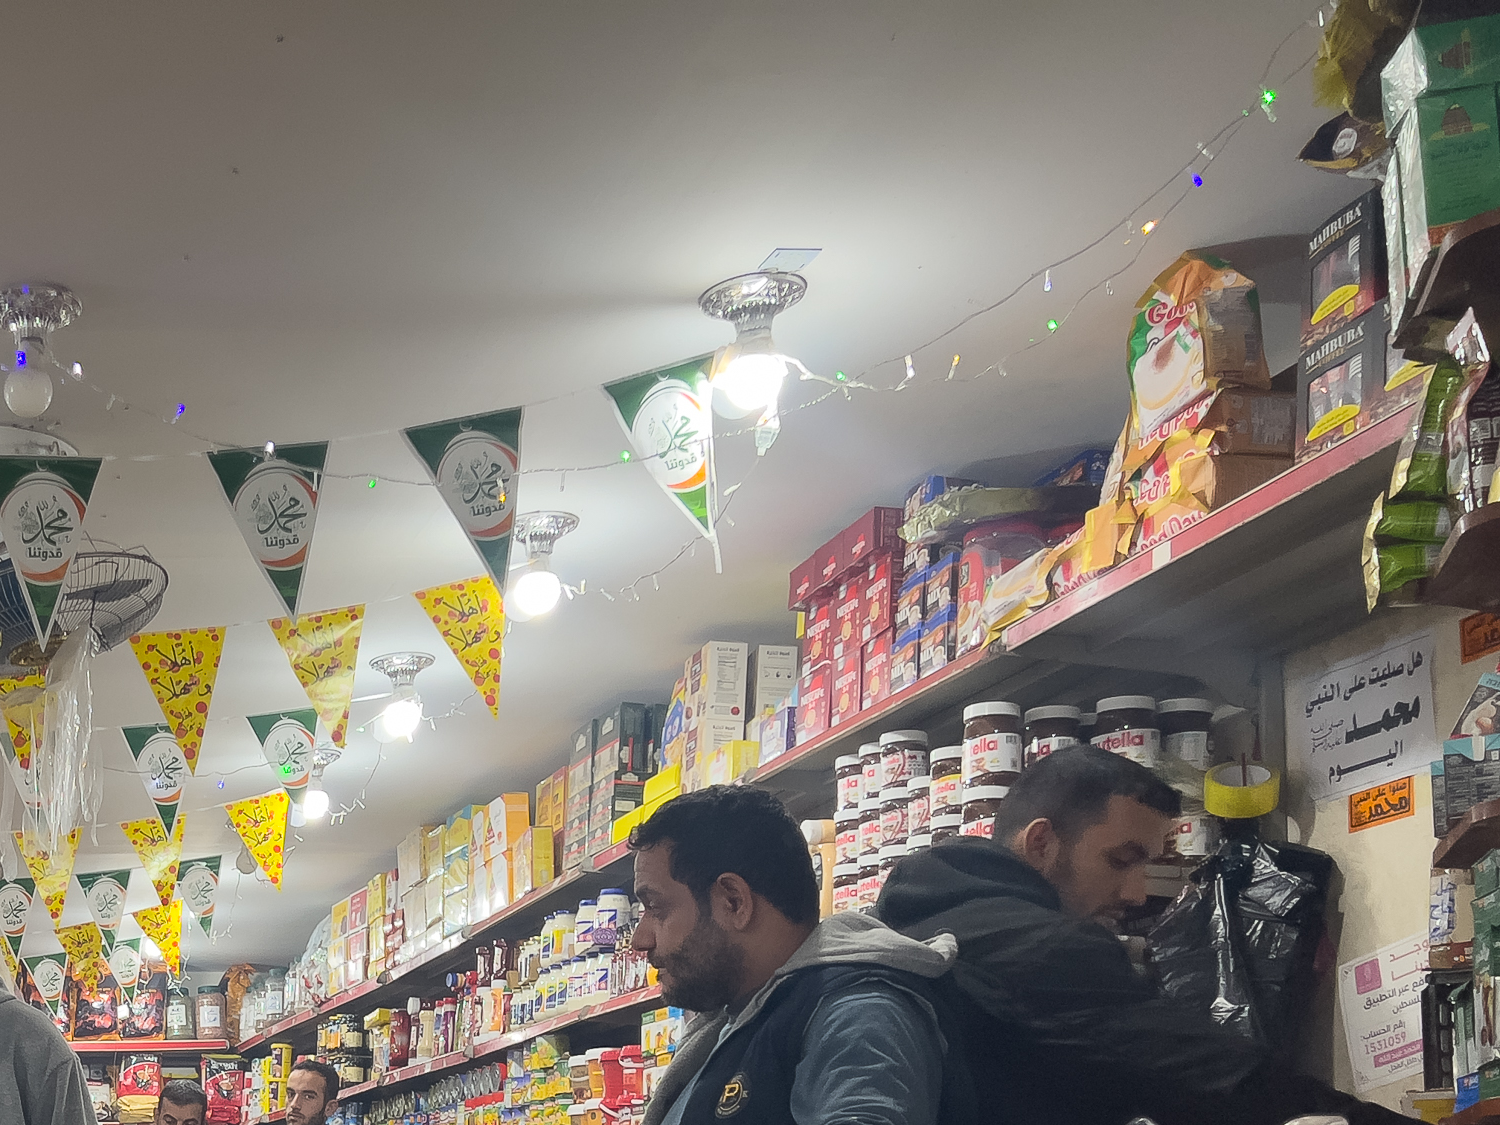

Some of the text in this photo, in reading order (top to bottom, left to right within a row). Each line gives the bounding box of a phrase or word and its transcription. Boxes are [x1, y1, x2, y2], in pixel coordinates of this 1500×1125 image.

[1309, 202, 1363, 253] MAHBUBA
[1305, 321, 1366, 371] MAHBUBA
[28, 546, 63, 559] قدوتنا
[264, 535, 300, 549] قدوتنا
[1305, 651, 1424, 719] هل صليت على النبي
[1344, 695, 1421, 745] محمد
[1328, 739, 1404, 785] اليوم
[1367, 795, 1410, 820] محمد
[1389, 939, 1430, 963] وجد
[1363, 989, 1397, 1011] التطبيق
[1364, 1031, 1407, 1055] 1531059
